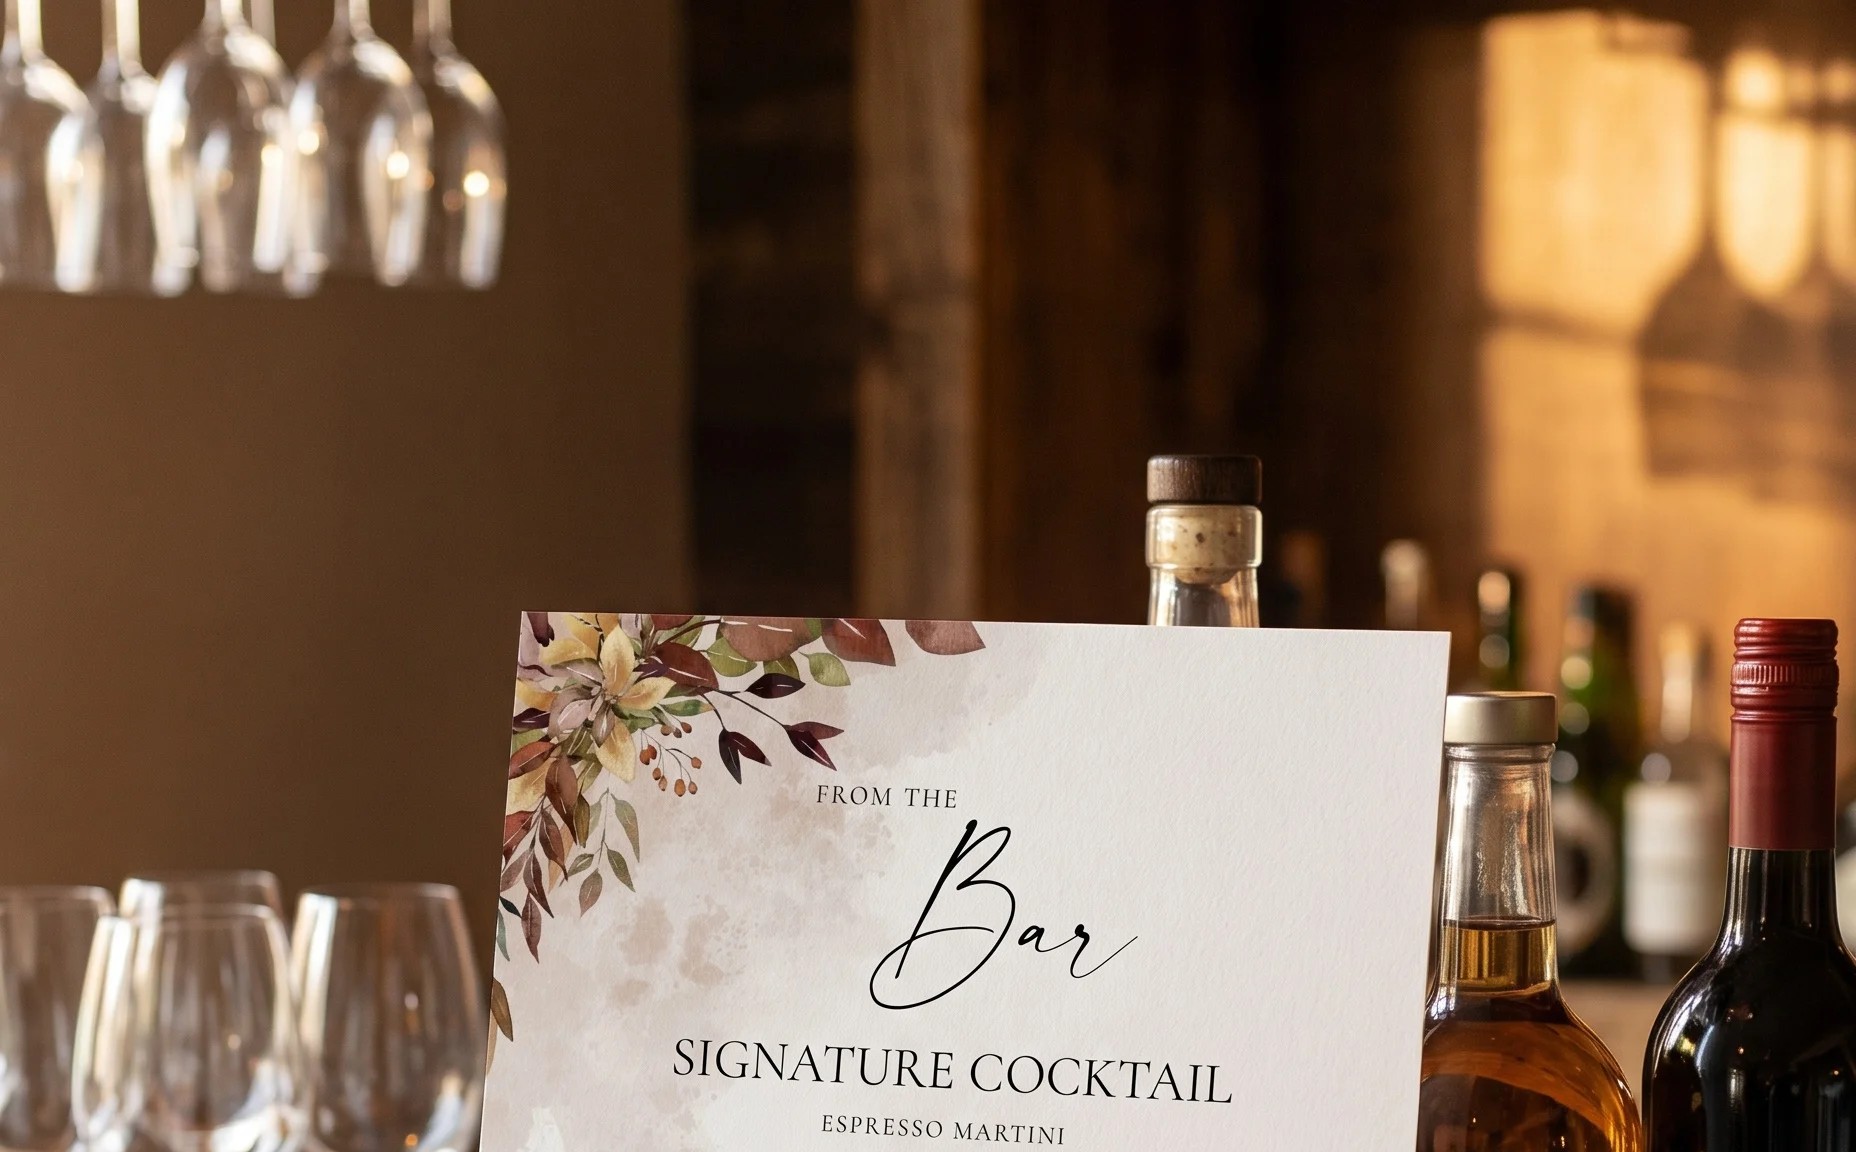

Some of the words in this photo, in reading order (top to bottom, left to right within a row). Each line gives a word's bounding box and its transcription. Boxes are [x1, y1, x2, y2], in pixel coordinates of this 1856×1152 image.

[816, 784, 892, 806] FROM
[904, 787, 957, 809] THE
[869, 818, 1139, 1011] Bar
[673, 1038, 954, 1090] SIGNATURE
[970, 1053, 1233, 1104] COCKTAIL
[821, 1114, 943, 1139] ESPRESSO
[952, 1121, 1065, 1146] MARTINI
